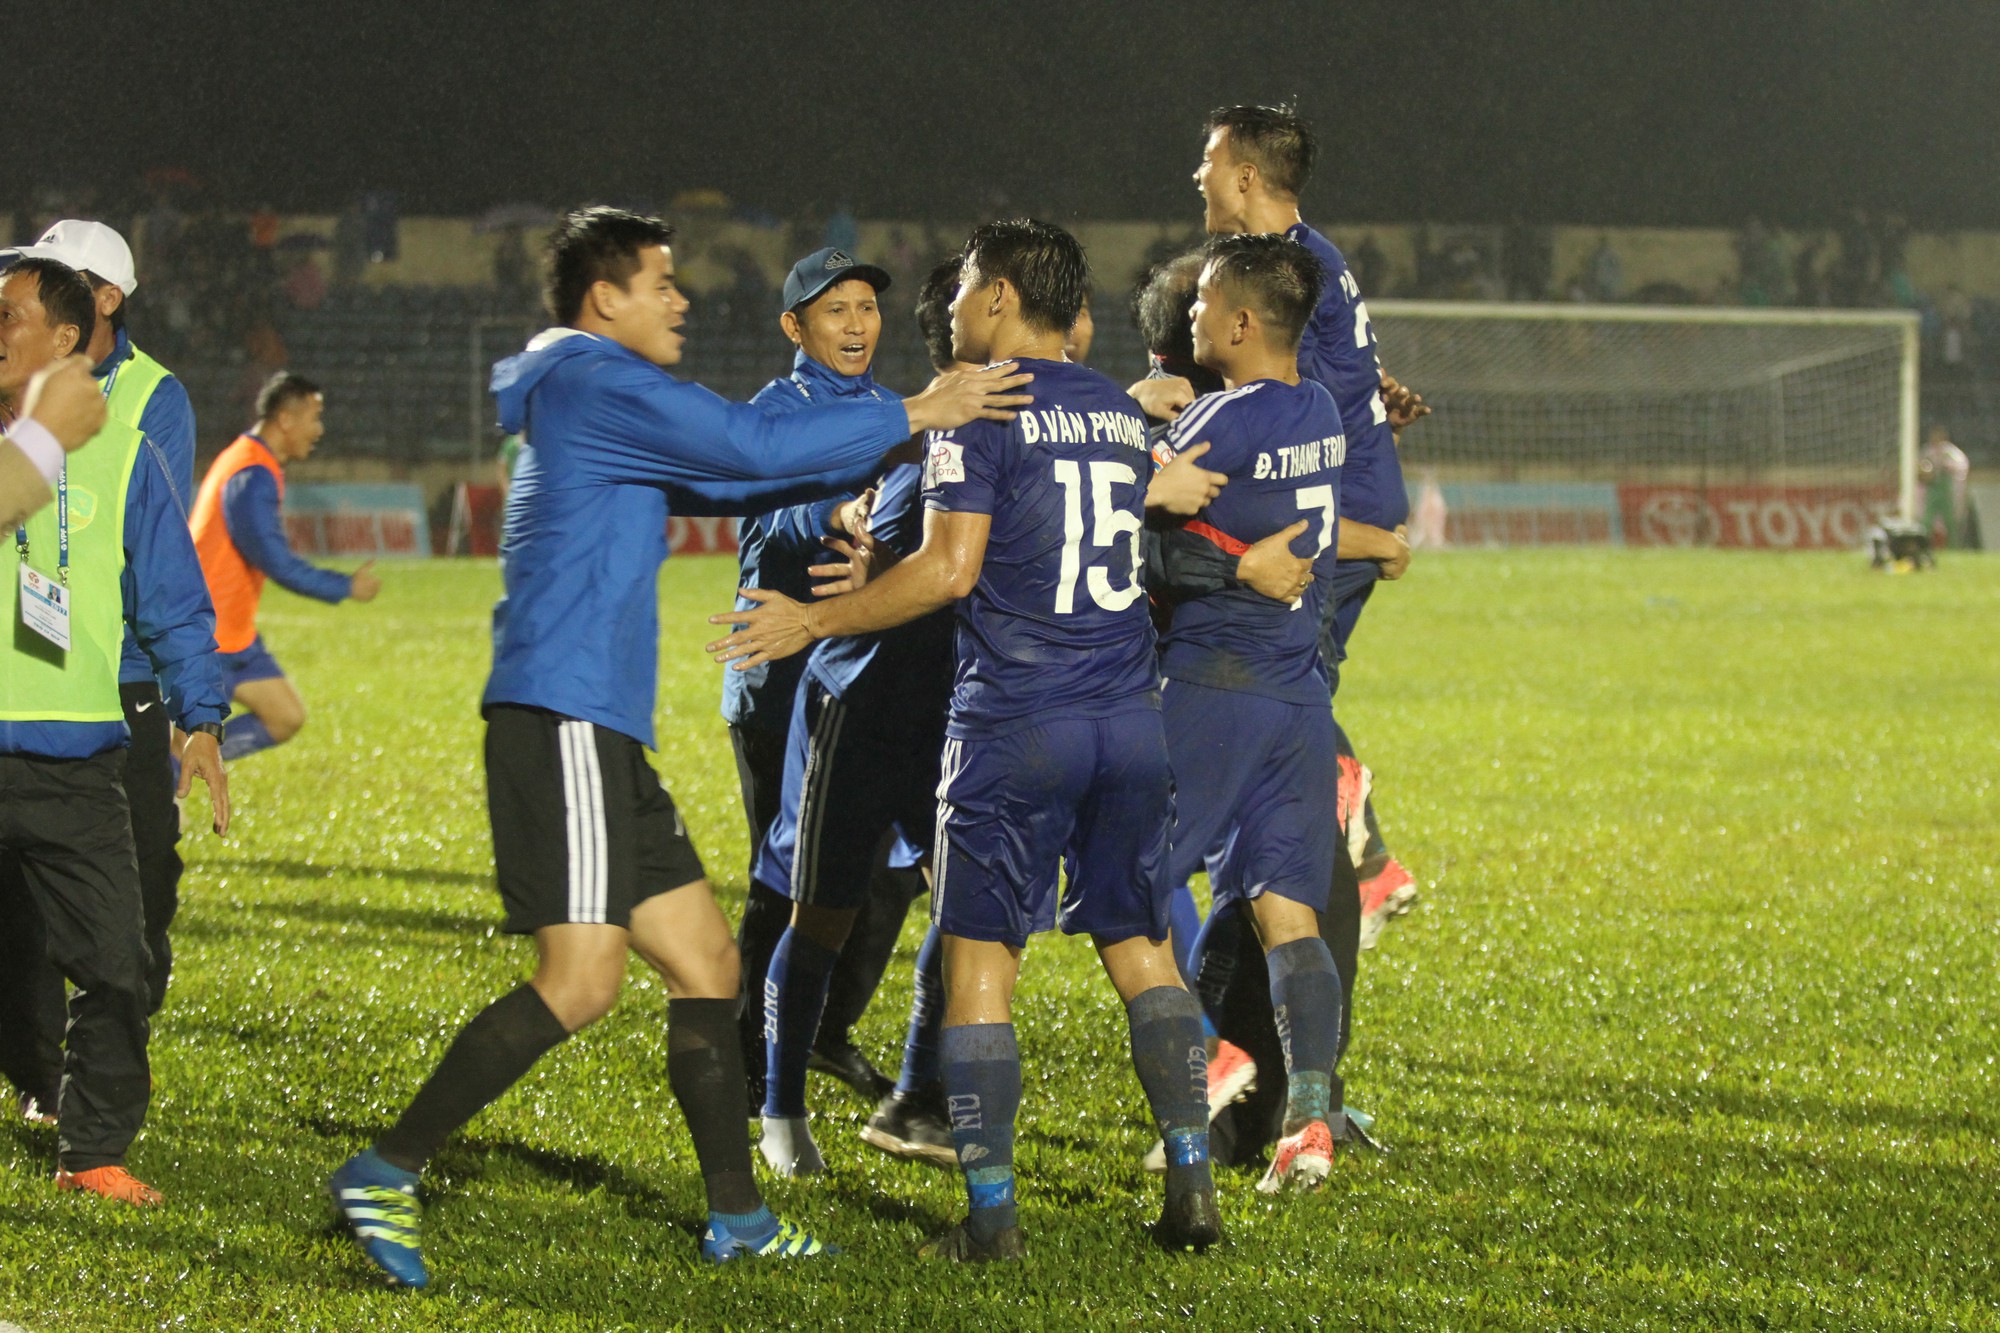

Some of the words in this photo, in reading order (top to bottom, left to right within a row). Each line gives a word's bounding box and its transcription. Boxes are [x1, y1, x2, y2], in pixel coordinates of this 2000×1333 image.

[1019, 404, 1087, 444] Đ.VĂN
[1087, 410, 1147, 451] PHONG
[1253, 440, 1321, 480] Đ.THANH
[60, 528, 68, 544] VPF
[1054, 459, 1143, 615] 15
[1291, 484, 1335, 612] 7
